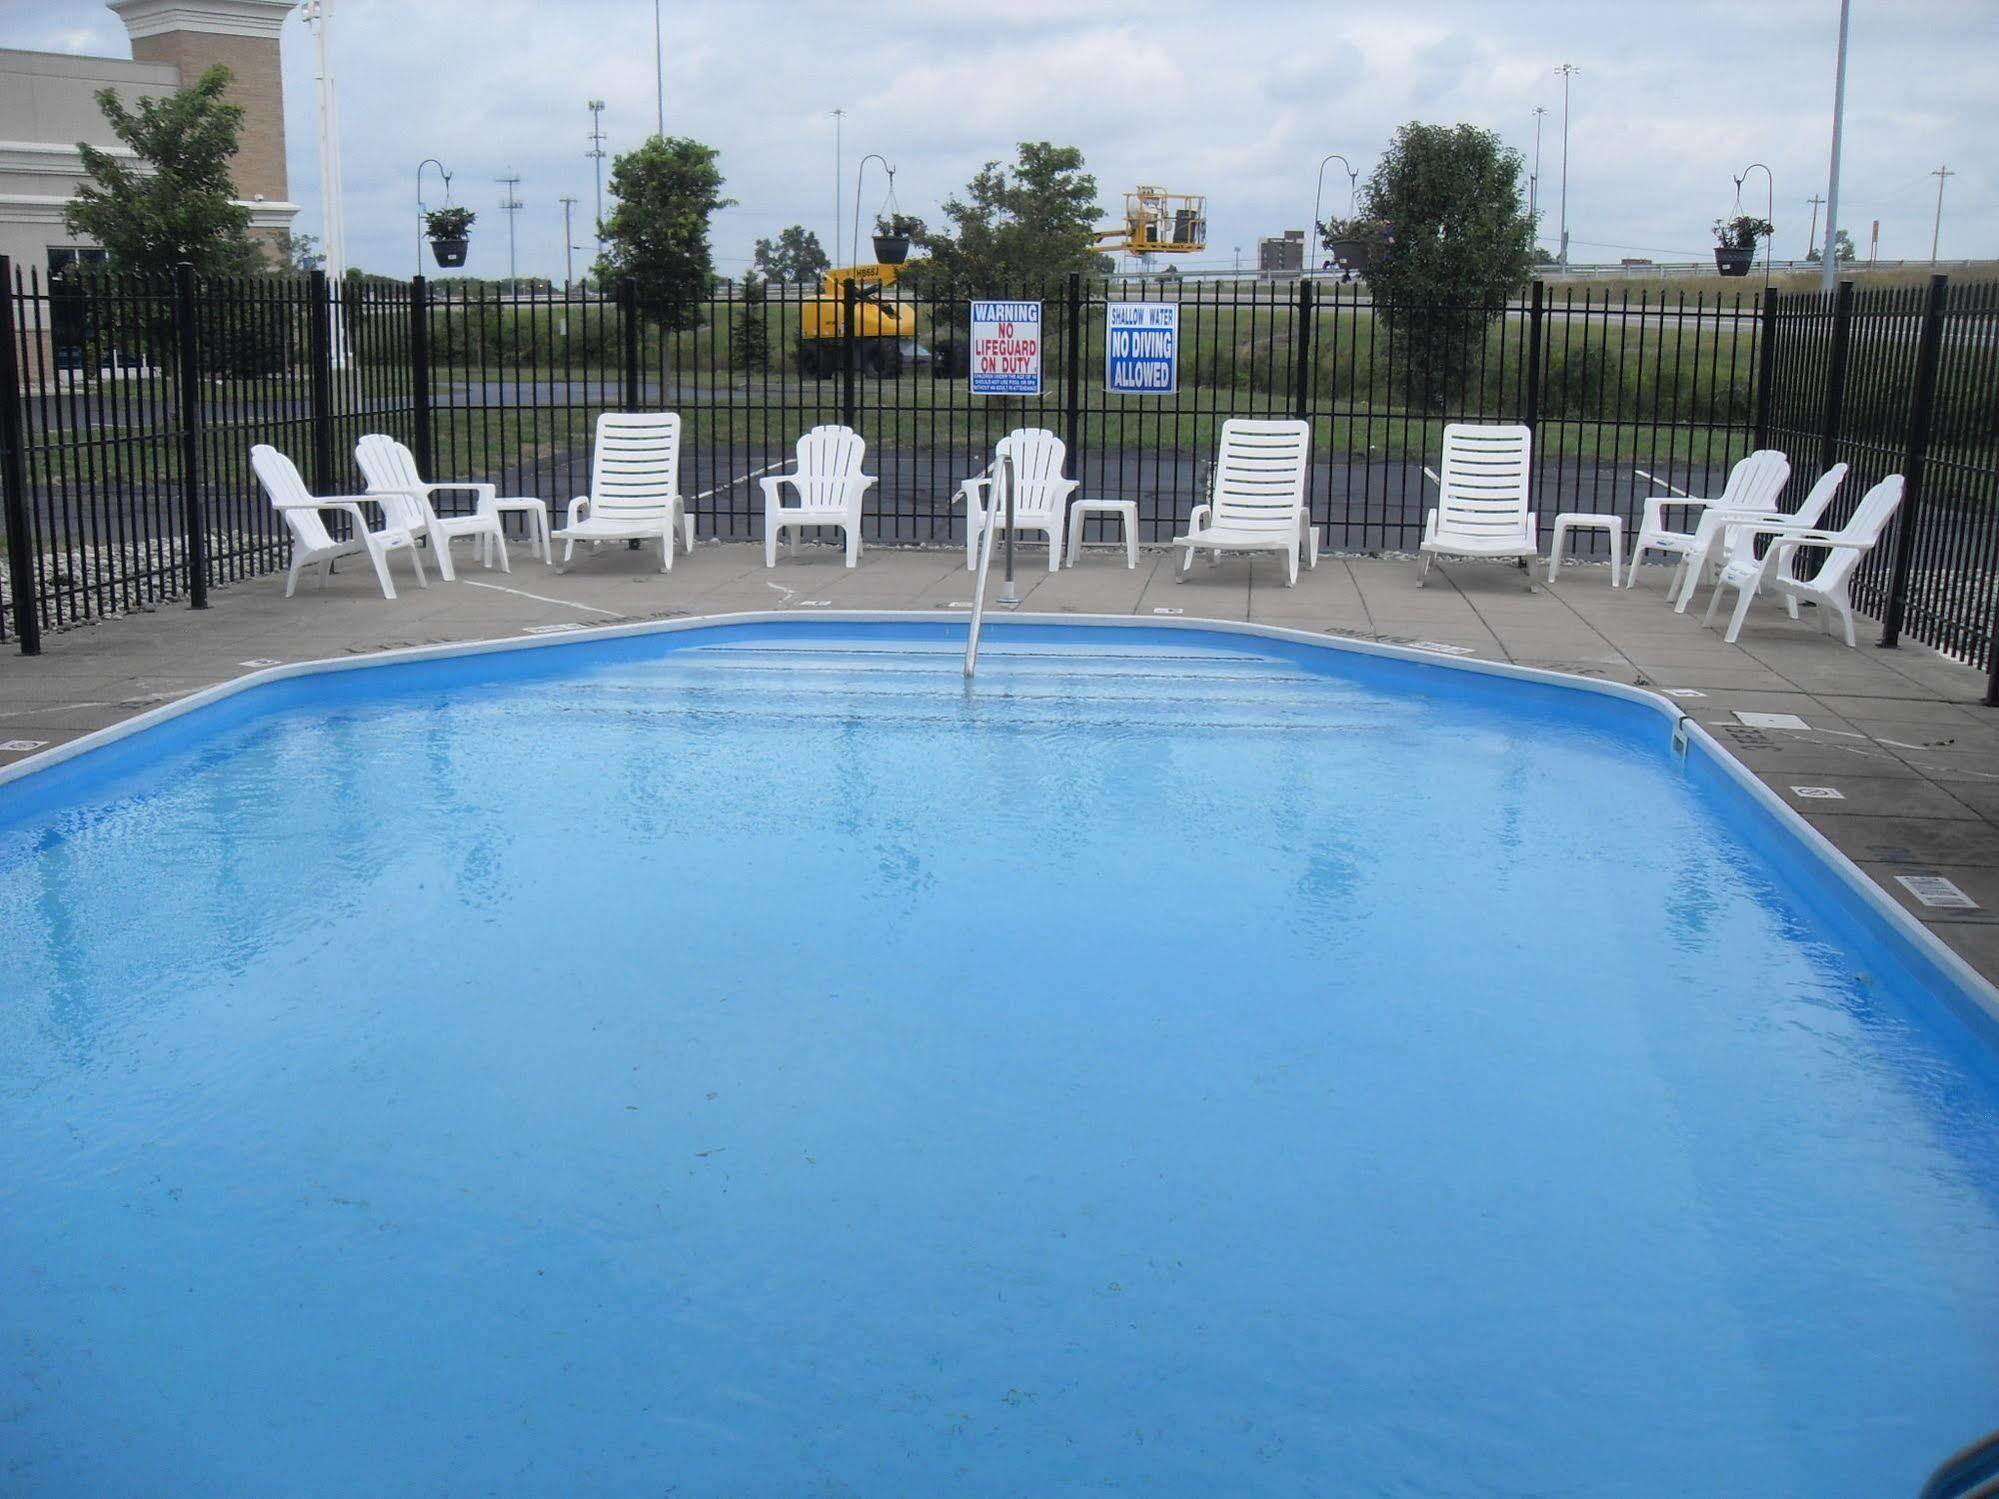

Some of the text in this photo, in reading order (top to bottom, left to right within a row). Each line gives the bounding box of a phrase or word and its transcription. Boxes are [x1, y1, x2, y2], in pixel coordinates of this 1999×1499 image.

[975, 304, 1037, 321] WARNING
[1112, 308, 1173, 325] SHALLOW WATER
[998, 322, 1014, 339] NO
[975, 340, 1036, 356] LIFEGUARD
[1112, 331, 1172, 358] NO DIVING
[981, 357, 1030, 373] ON DUTY
[1114, 361, 1169, 388] ALLOWED
